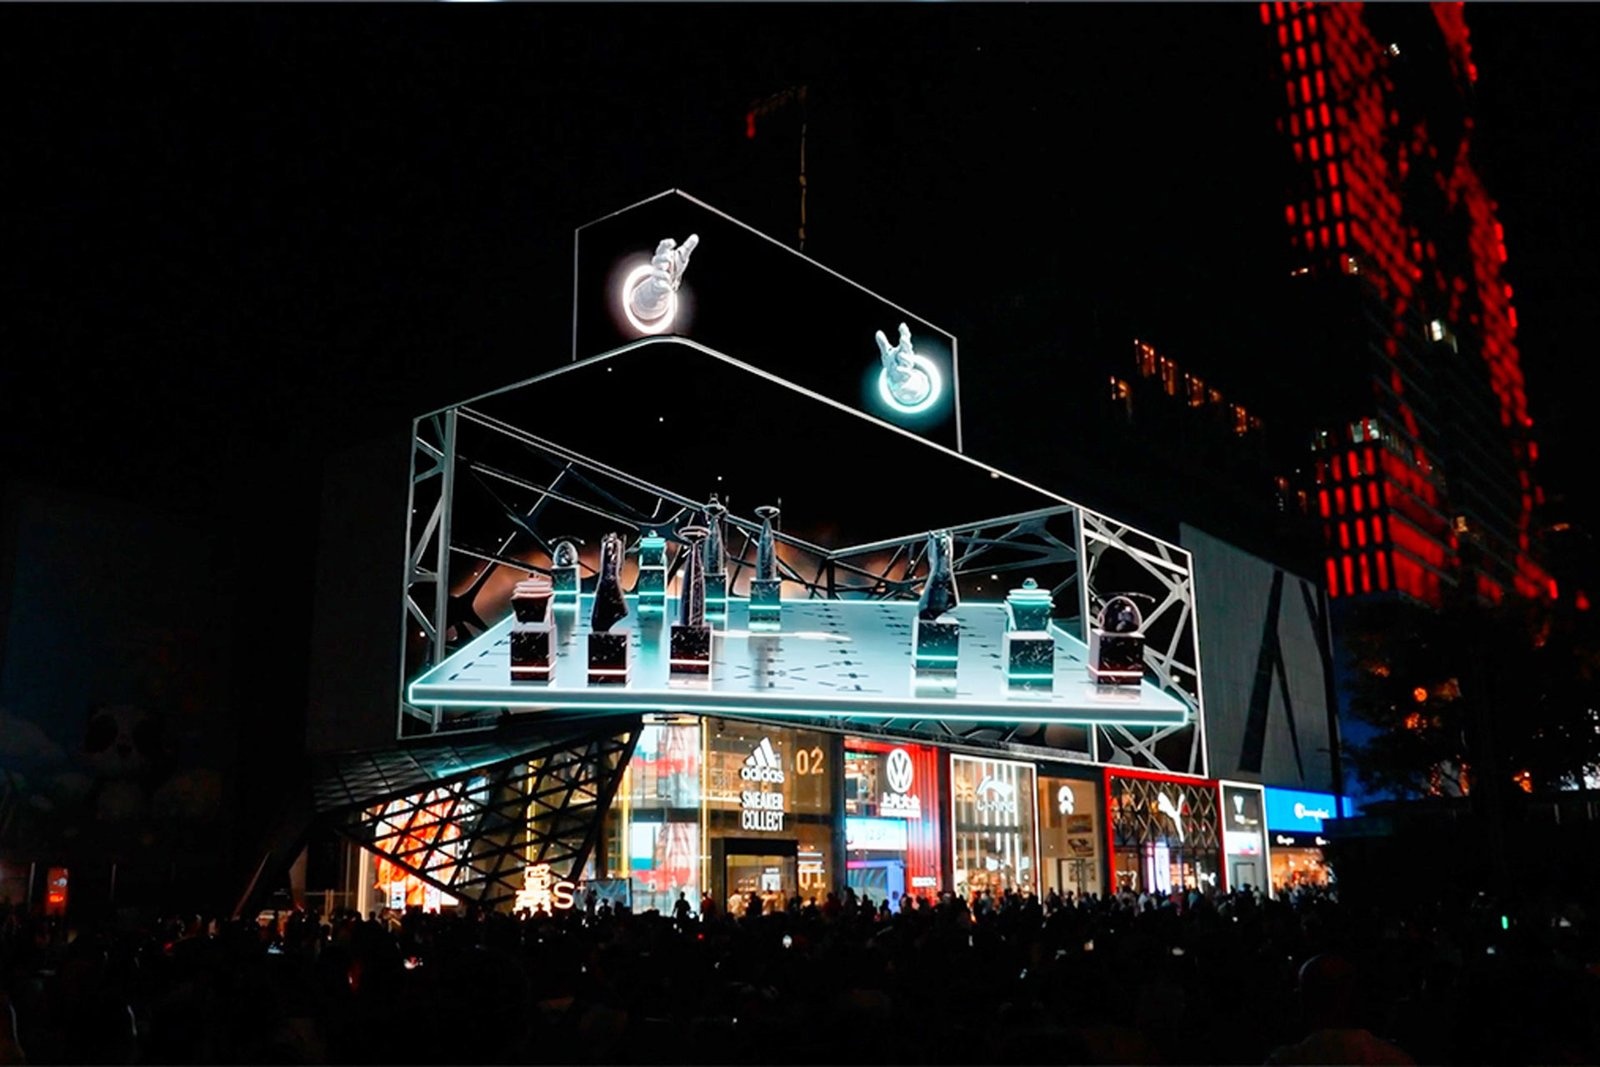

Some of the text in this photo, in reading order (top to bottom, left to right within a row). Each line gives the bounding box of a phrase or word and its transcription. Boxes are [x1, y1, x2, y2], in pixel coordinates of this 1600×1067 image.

[796, 747, 824, 775] 02
[741, 765, 784, 784] adidas
[742, 790, 784, 810] SNEAKER
[742, 810, 785, 831] COLLECT
